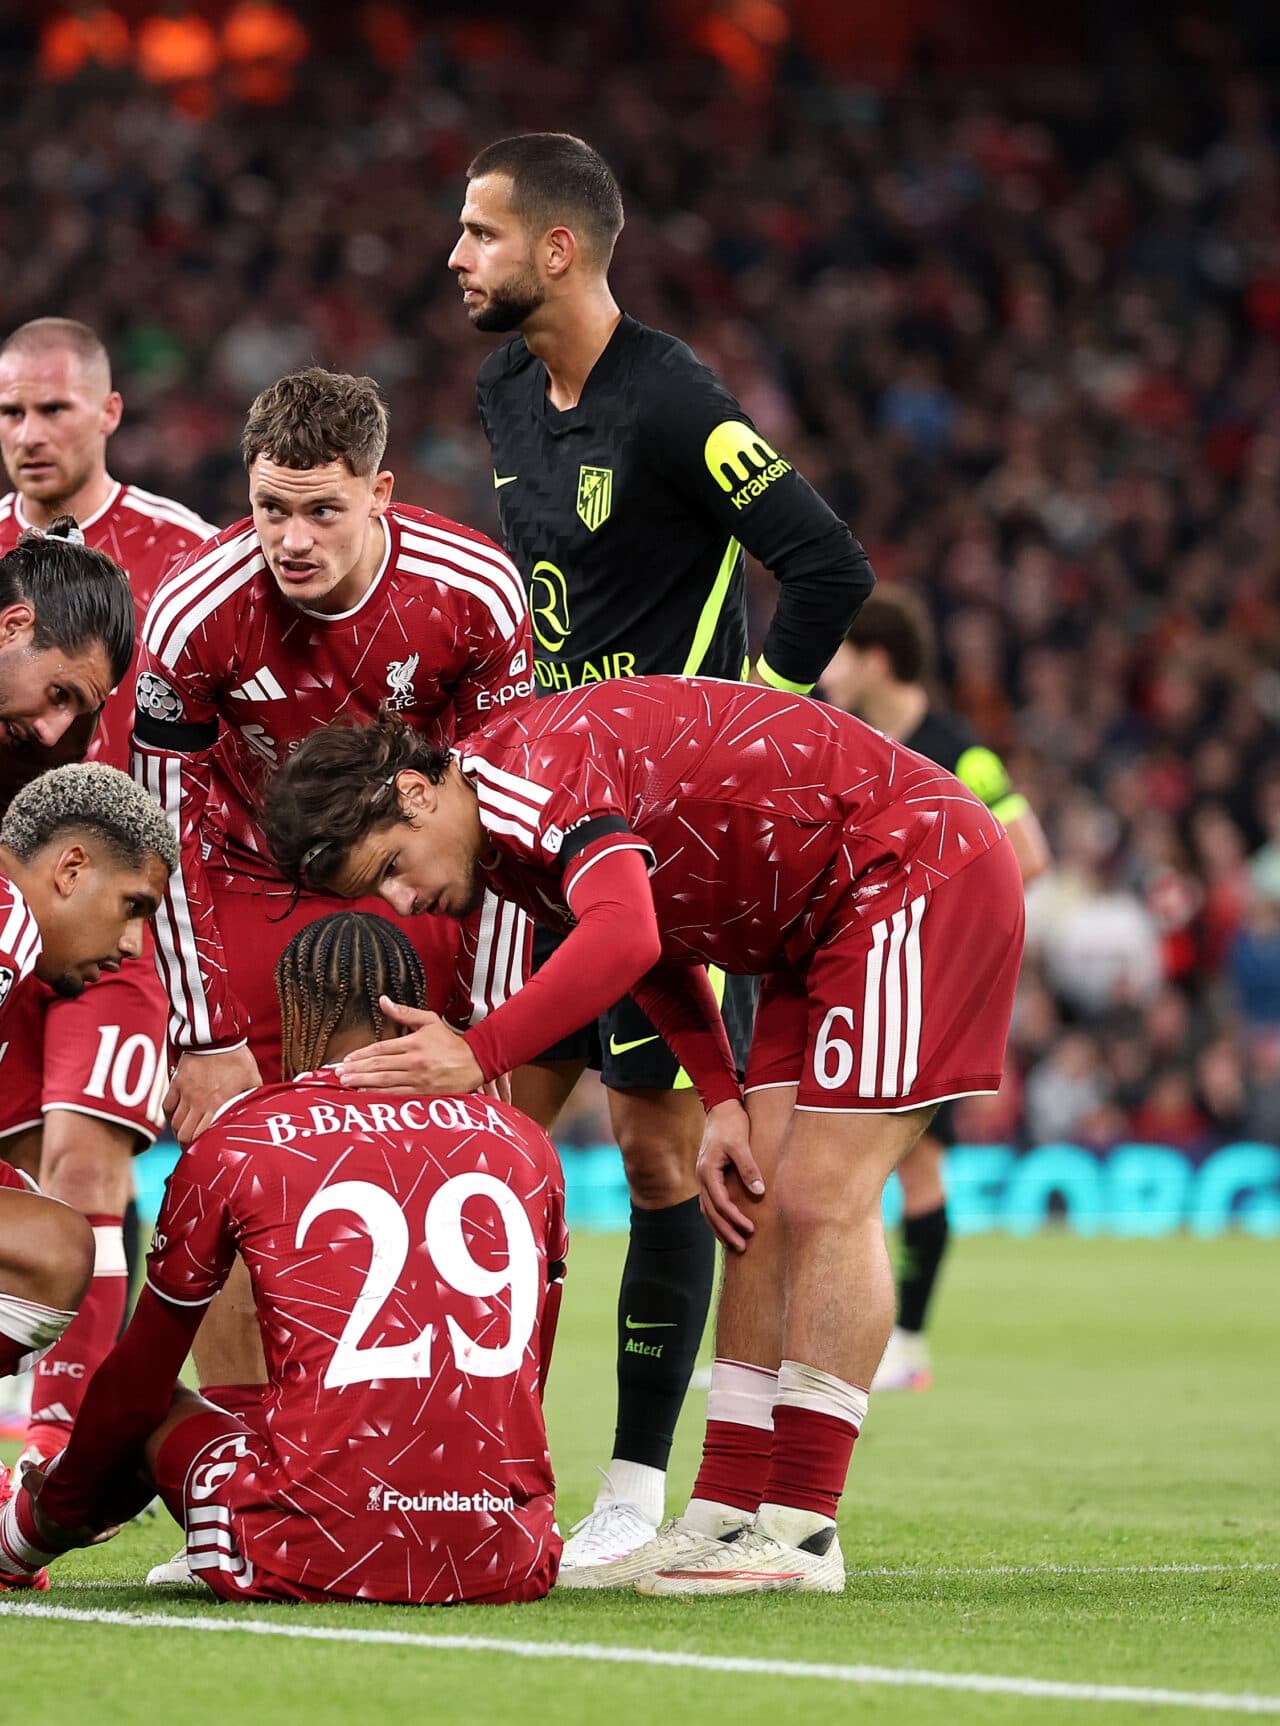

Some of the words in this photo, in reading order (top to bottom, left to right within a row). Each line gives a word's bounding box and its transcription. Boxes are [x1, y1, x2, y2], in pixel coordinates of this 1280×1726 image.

[731, 459, 792, 510] kraken
[477, 672, 535, 711] Expe
[581, 652, 636, 686] AIR
[82, 1024, 157, 1108] 10
[814, 1006, 854, 1090] 6
[265, 1099, 515, 1145] B.BARCOLA
[295, 1172, 539, 1389] 29
[39, 1360, 86, 1379] LFC
[383, 1489, 515, 1513] Foundation
